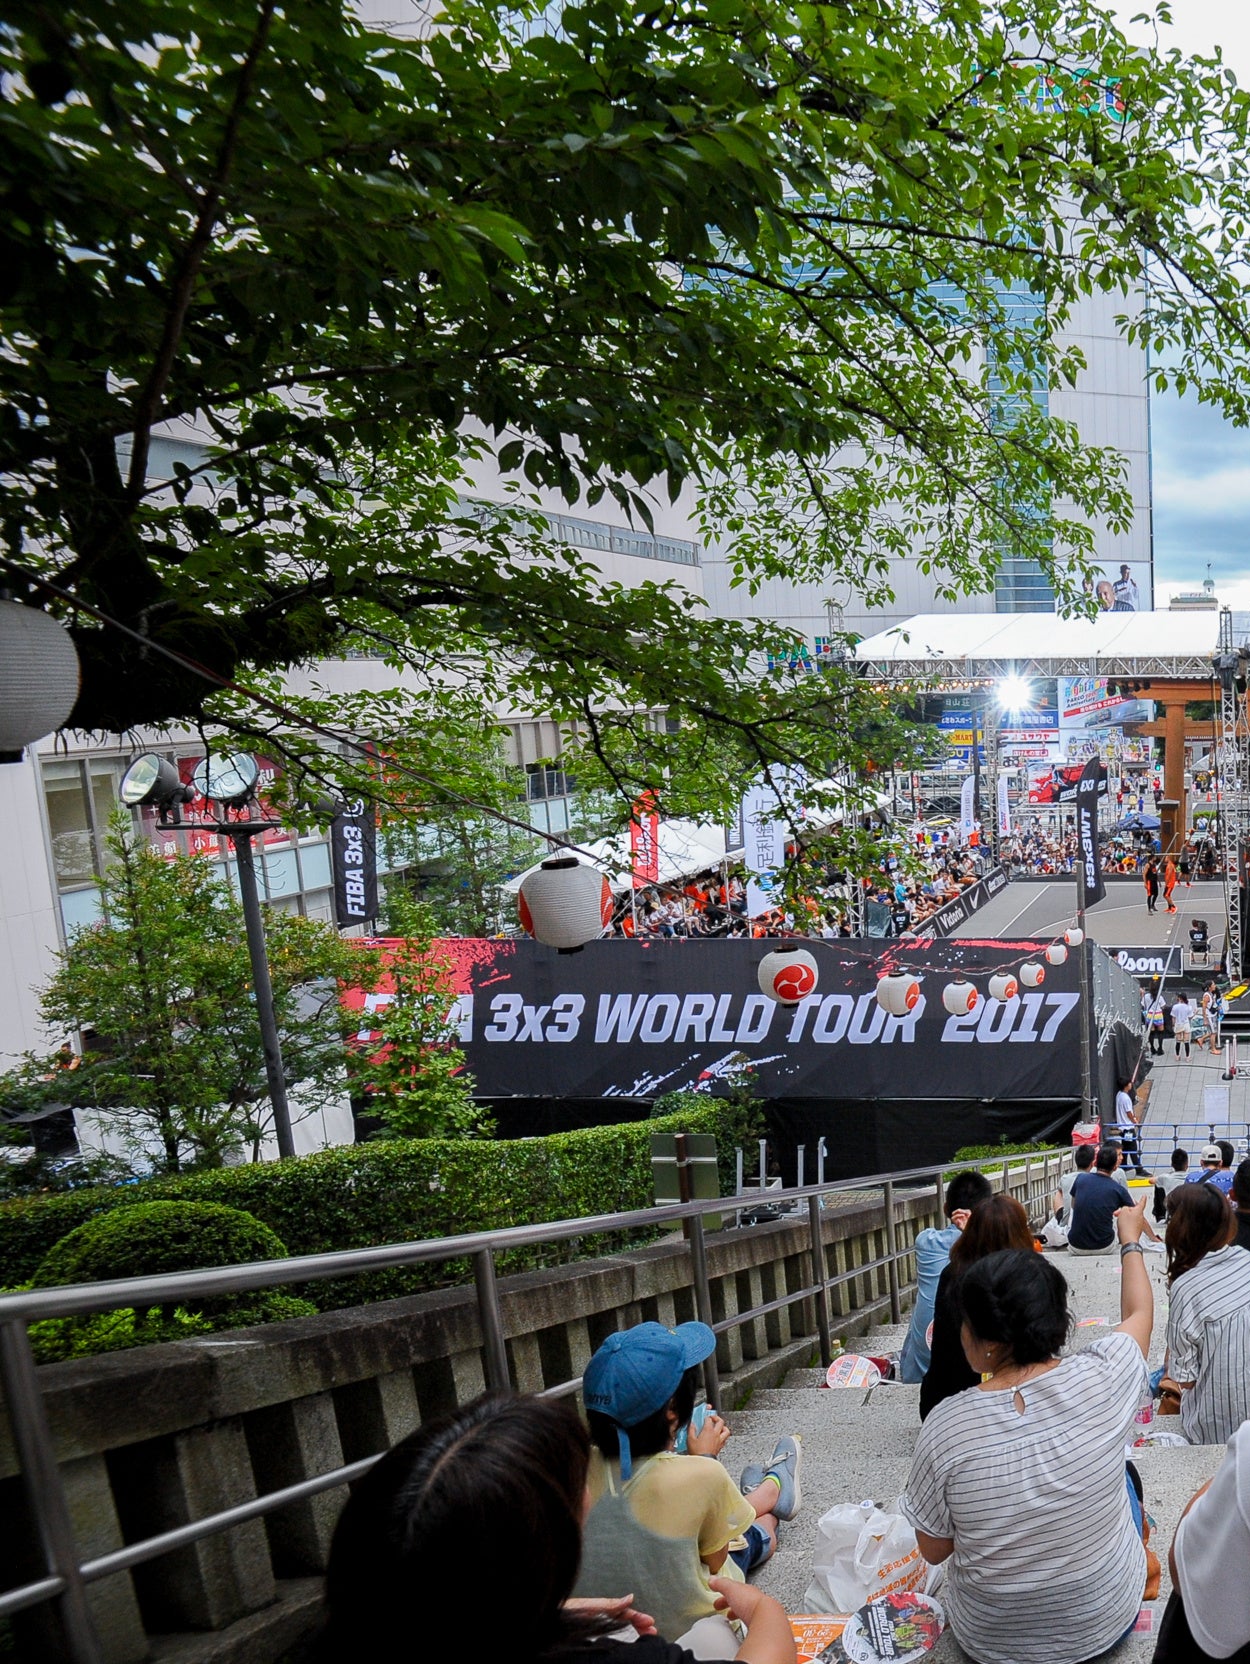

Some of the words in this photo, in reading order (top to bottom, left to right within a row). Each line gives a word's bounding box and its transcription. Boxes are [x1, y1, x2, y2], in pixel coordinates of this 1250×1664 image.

[343, 825, 363, 864] 3x3
[346, 869, 366, 917] FIBA
[1118, 951, 1165, 972] lson
[484, 993, 587, 1042] 3x3
[594, 993, 776, 1043] WORLD
[788, 993, 928, 1044] TOUR
[941, 992, 1080, 1043] 2017
[876, 1606, 890, 1634] WORLD
[882, 1634, 895, 1657] TOUR
